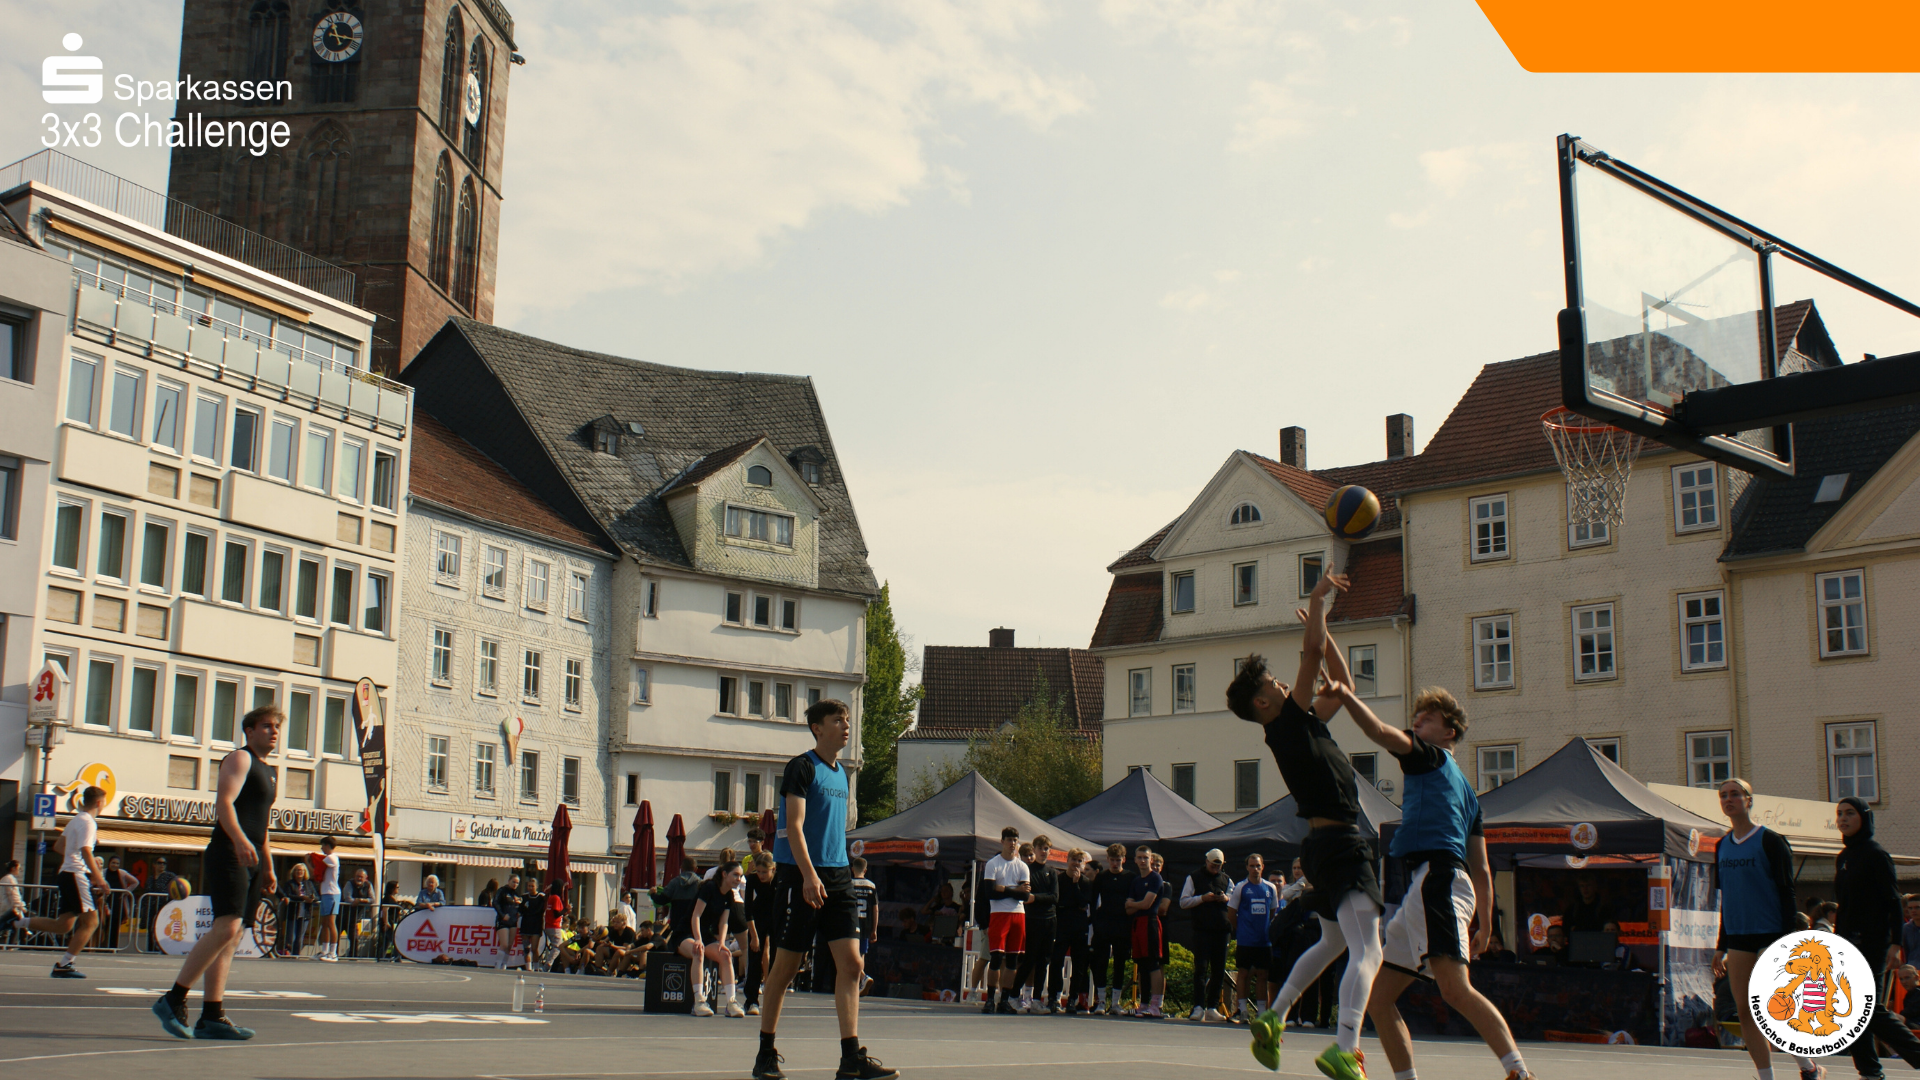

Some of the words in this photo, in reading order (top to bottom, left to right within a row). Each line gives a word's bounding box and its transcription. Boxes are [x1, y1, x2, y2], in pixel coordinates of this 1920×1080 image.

[38, 797, 51, 815] P
[123, 795, 217, 822] SCHWAN
[269, 808, 354, 831] POTHEKE
[470, 821, 511, 840] Gelateria
[1540, 831, 1568, 839] Verband
[407, 939, 445, 952] PEAK
[447, 947, 481, 955] PEAK
[663, 991, 684, 1001] DBB
